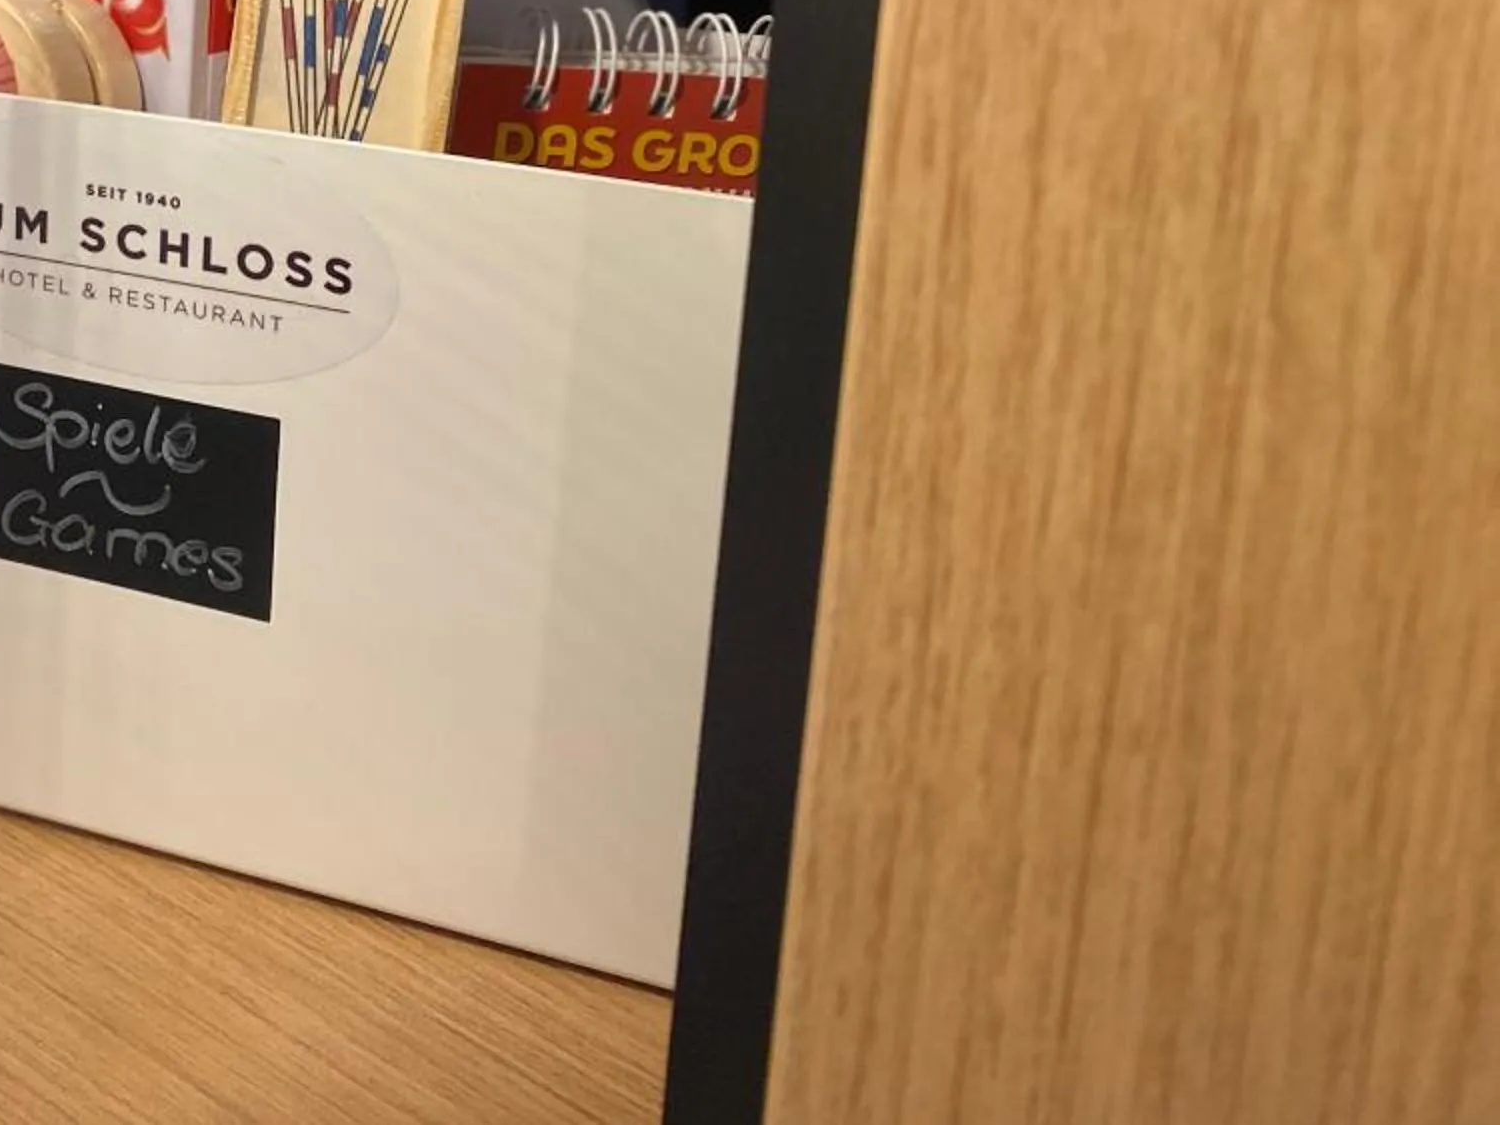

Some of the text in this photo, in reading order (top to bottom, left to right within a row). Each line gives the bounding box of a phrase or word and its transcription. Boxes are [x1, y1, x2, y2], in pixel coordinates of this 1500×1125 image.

[495, 121, 761, 177] DAS GRO
[85, 183, 181, 210] SEIT 1940
[79, 216, 353, 295] SCHLOSS
[81, 282, 98, 300] &
[108, 286, 283, 332] RESTAURANT
[1, 488, 243, 593] Games
